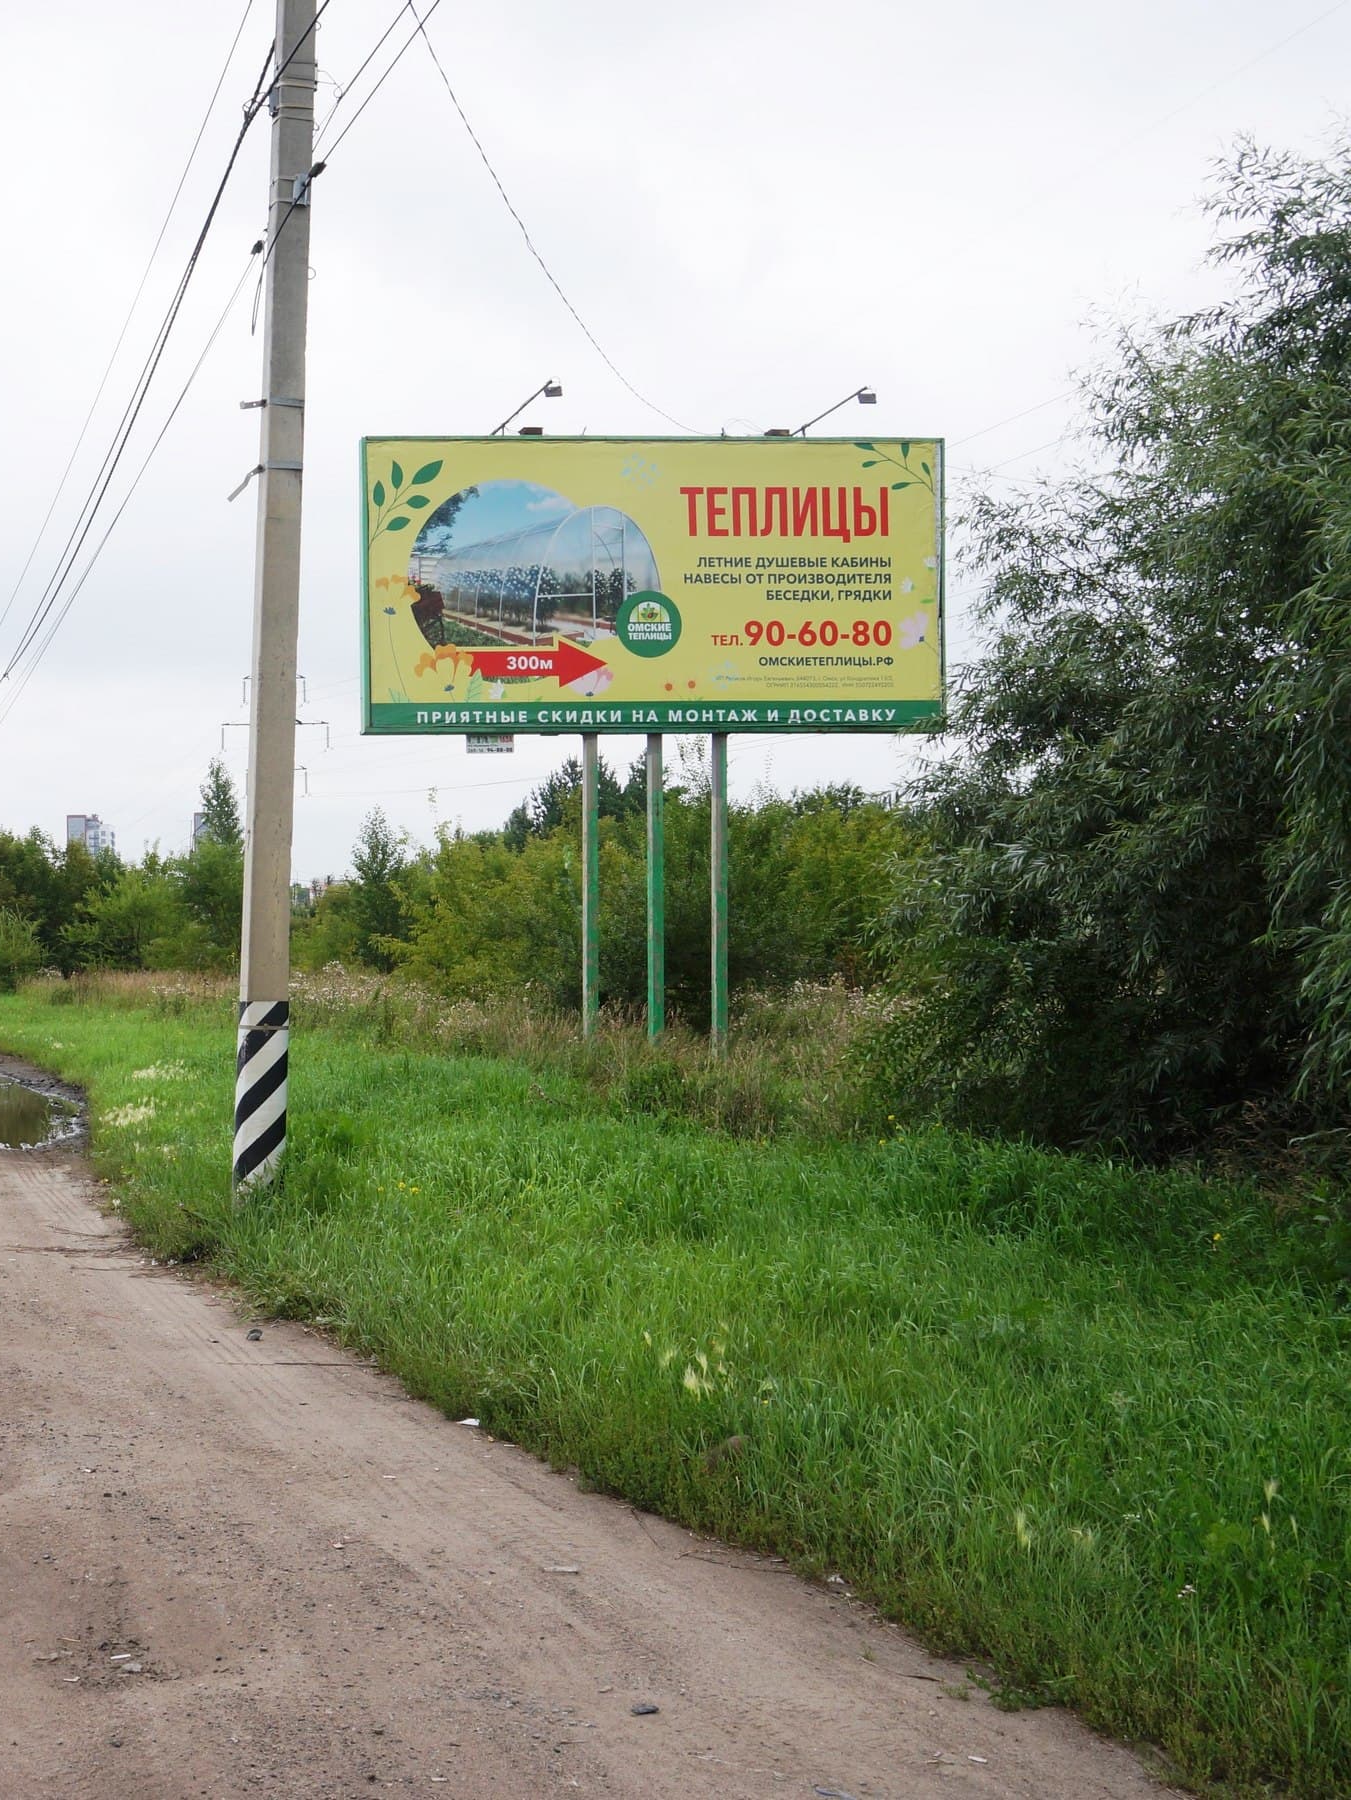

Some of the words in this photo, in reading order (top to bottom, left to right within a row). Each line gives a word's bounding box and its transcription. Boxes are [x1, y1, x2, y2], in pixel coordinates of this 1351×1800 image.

[680, 487, 889, 543] ТЕПЛИЦЫ
[697, 557, 752, 568] ЛЕТНИЕ
[755, 557, 827, 569] ДУШЕВЫЕ
[831, 557, 891, 568] КАБИНЫ
[684, 573, 742, 585] НАВЕСЫ
[745, 573, 764, 585] ОТ
[768, 573, 892, 586] ПРОИЗВОДИТЕЛЯ
[766, 590, 834, 602] БЕСЕДКИ,
[838, 590, 892, 602] ГРЯДКИ
[628, 623, 672, 632] ОМСКИЕ
[711, 634, 744, 647] ТЕЛ.
[744, 620, 893, 647] 90-60-80
[628, 632, 672, 642] ТЕПЛИЦЫ
[506, 656, 553, 670] 300м
[758, 656, 894, 668] ОМСКИЕТЕПЛИЦЫ.РФ
[416, 711, 528, 724] ПРИЯТНЫЕ
[537, 711, 623, 724] СКИДКИ
[632, 711, 659, 723] НА
[668, 709, 758, 723] МОНТАЖ
[767, 710, 779, 722] И
[788, 708, 897, 724] ДОСТАВКУ
